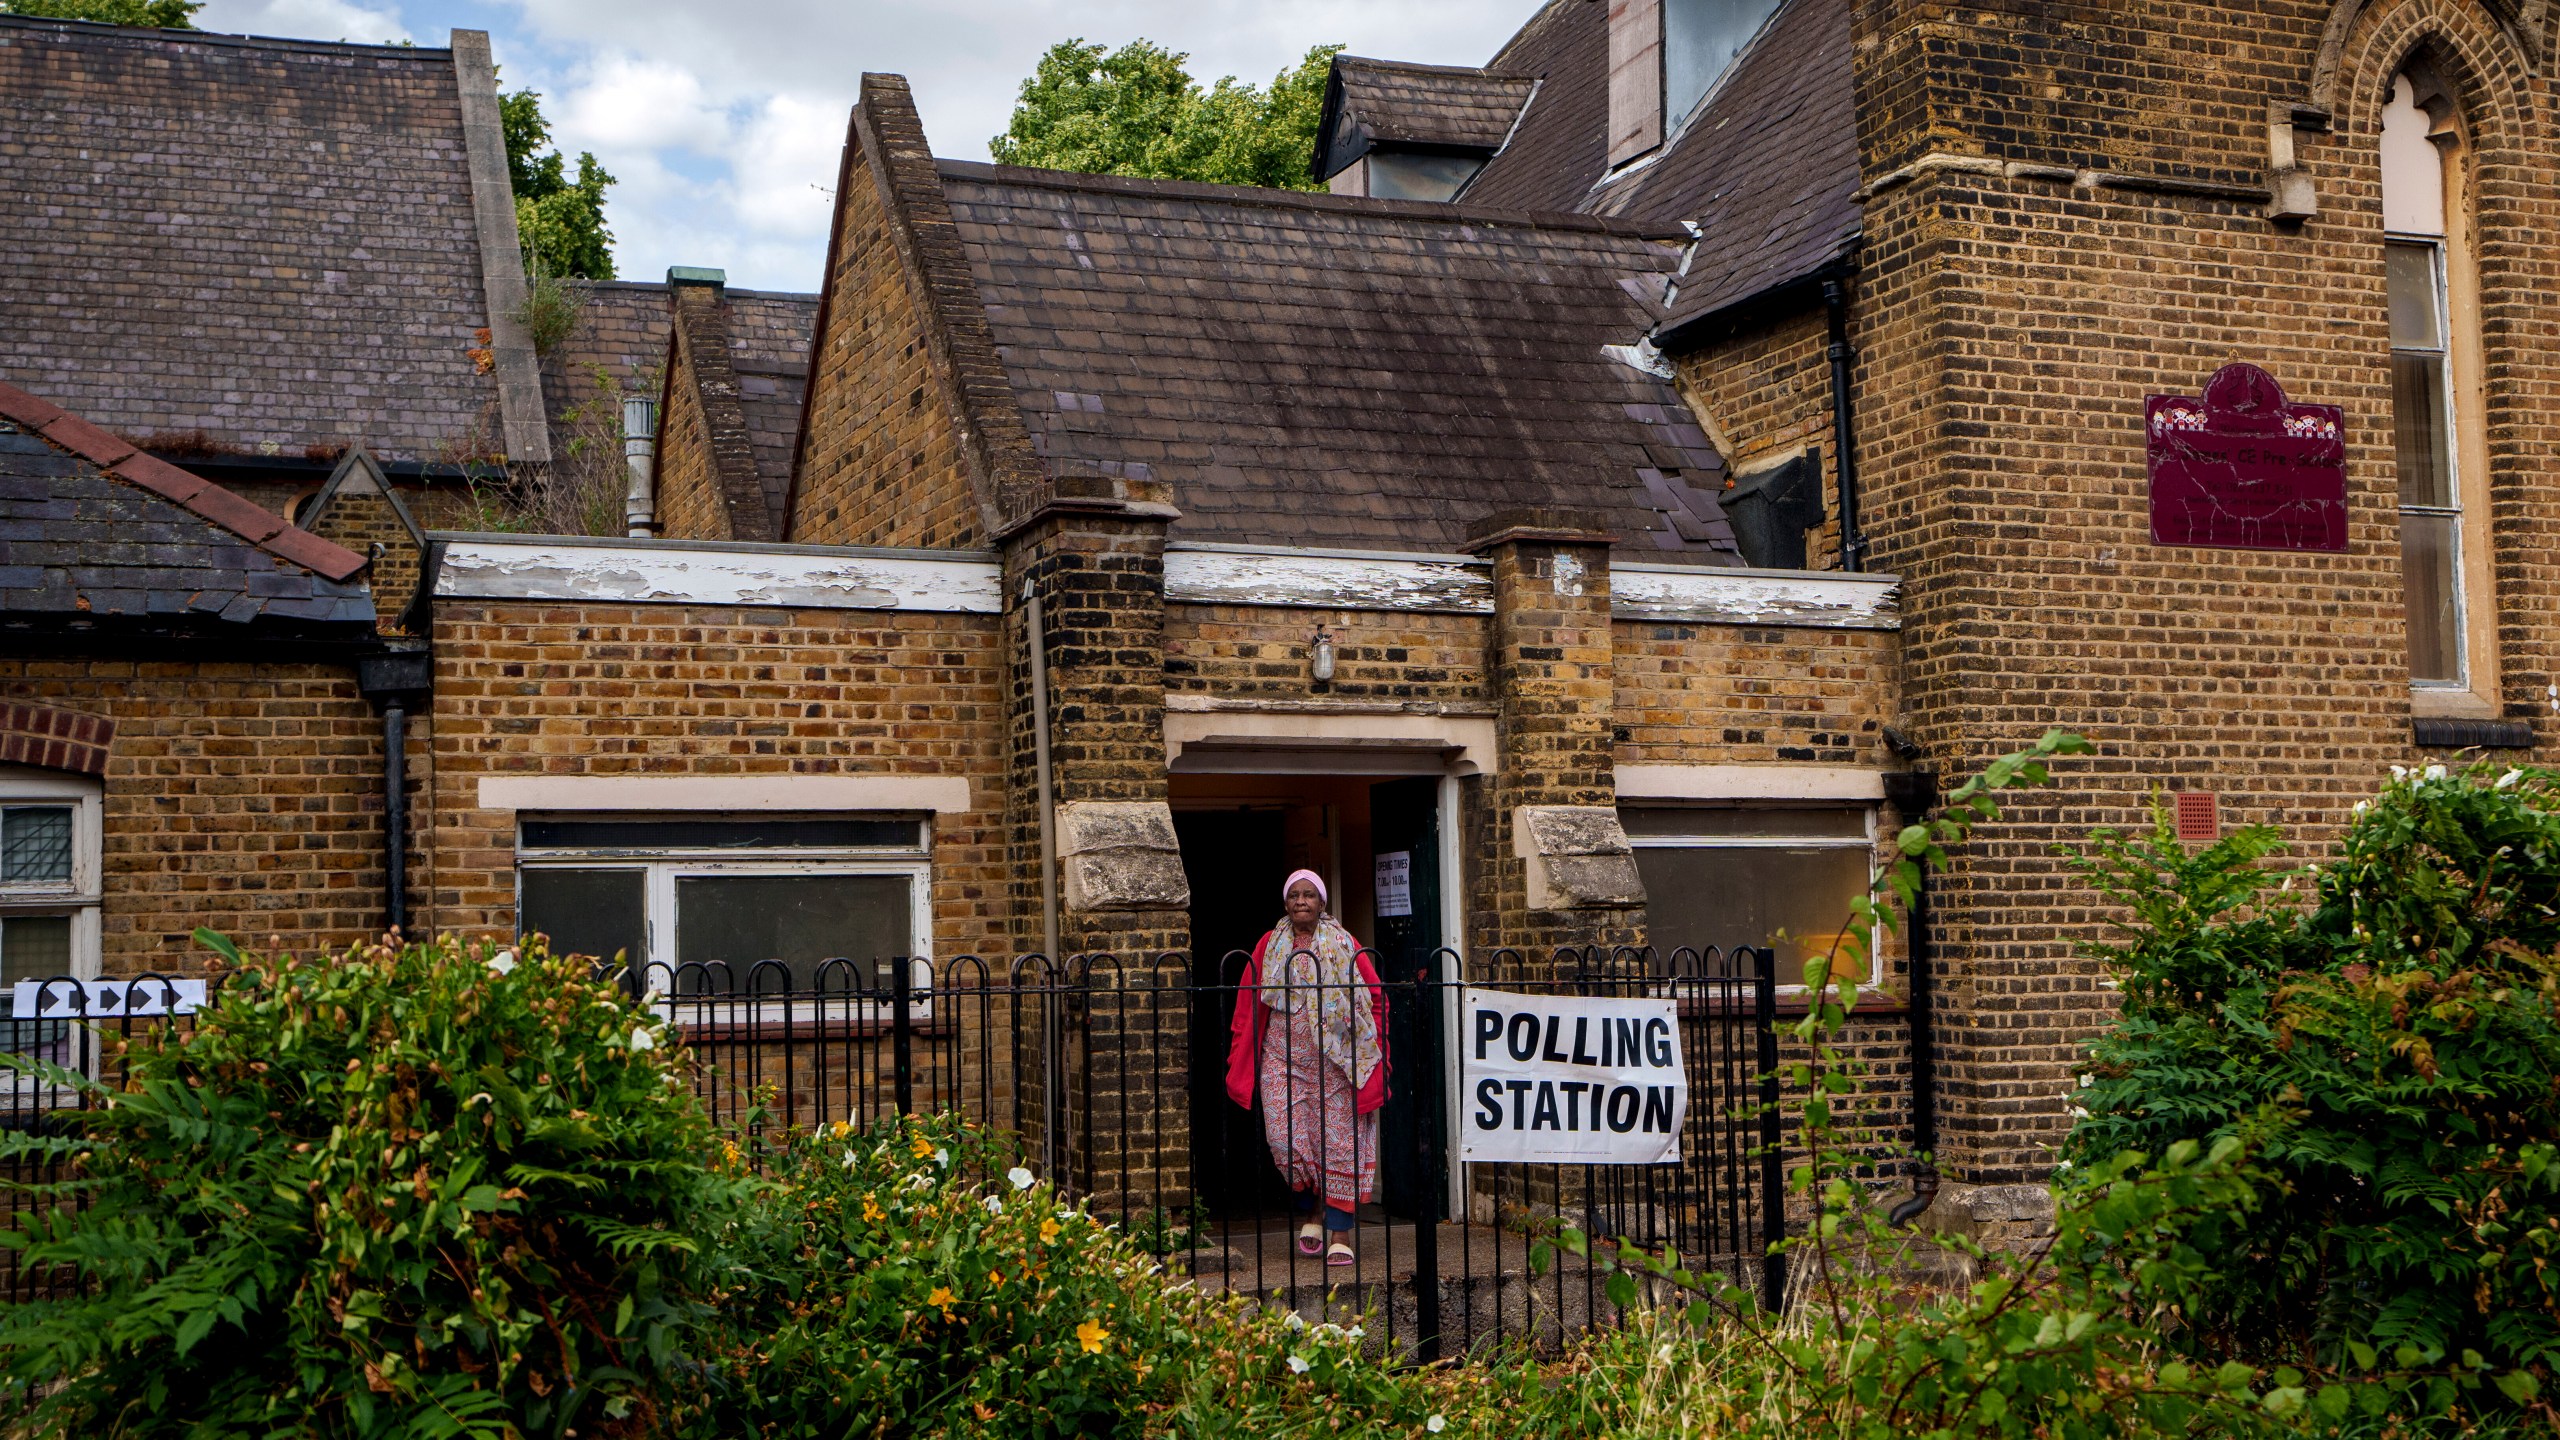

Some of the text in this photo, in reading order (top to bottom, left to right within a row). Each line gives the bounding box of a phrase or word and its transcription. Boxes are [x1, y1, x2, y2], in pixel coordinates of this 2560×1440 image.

[2237, 449, 2256, 464] CE
[1394, 858, 1408, 870] TIMES
[1475, 1009, 1673, 1068] POLLING
[1475, 1078, 1674, 1134] STATION
